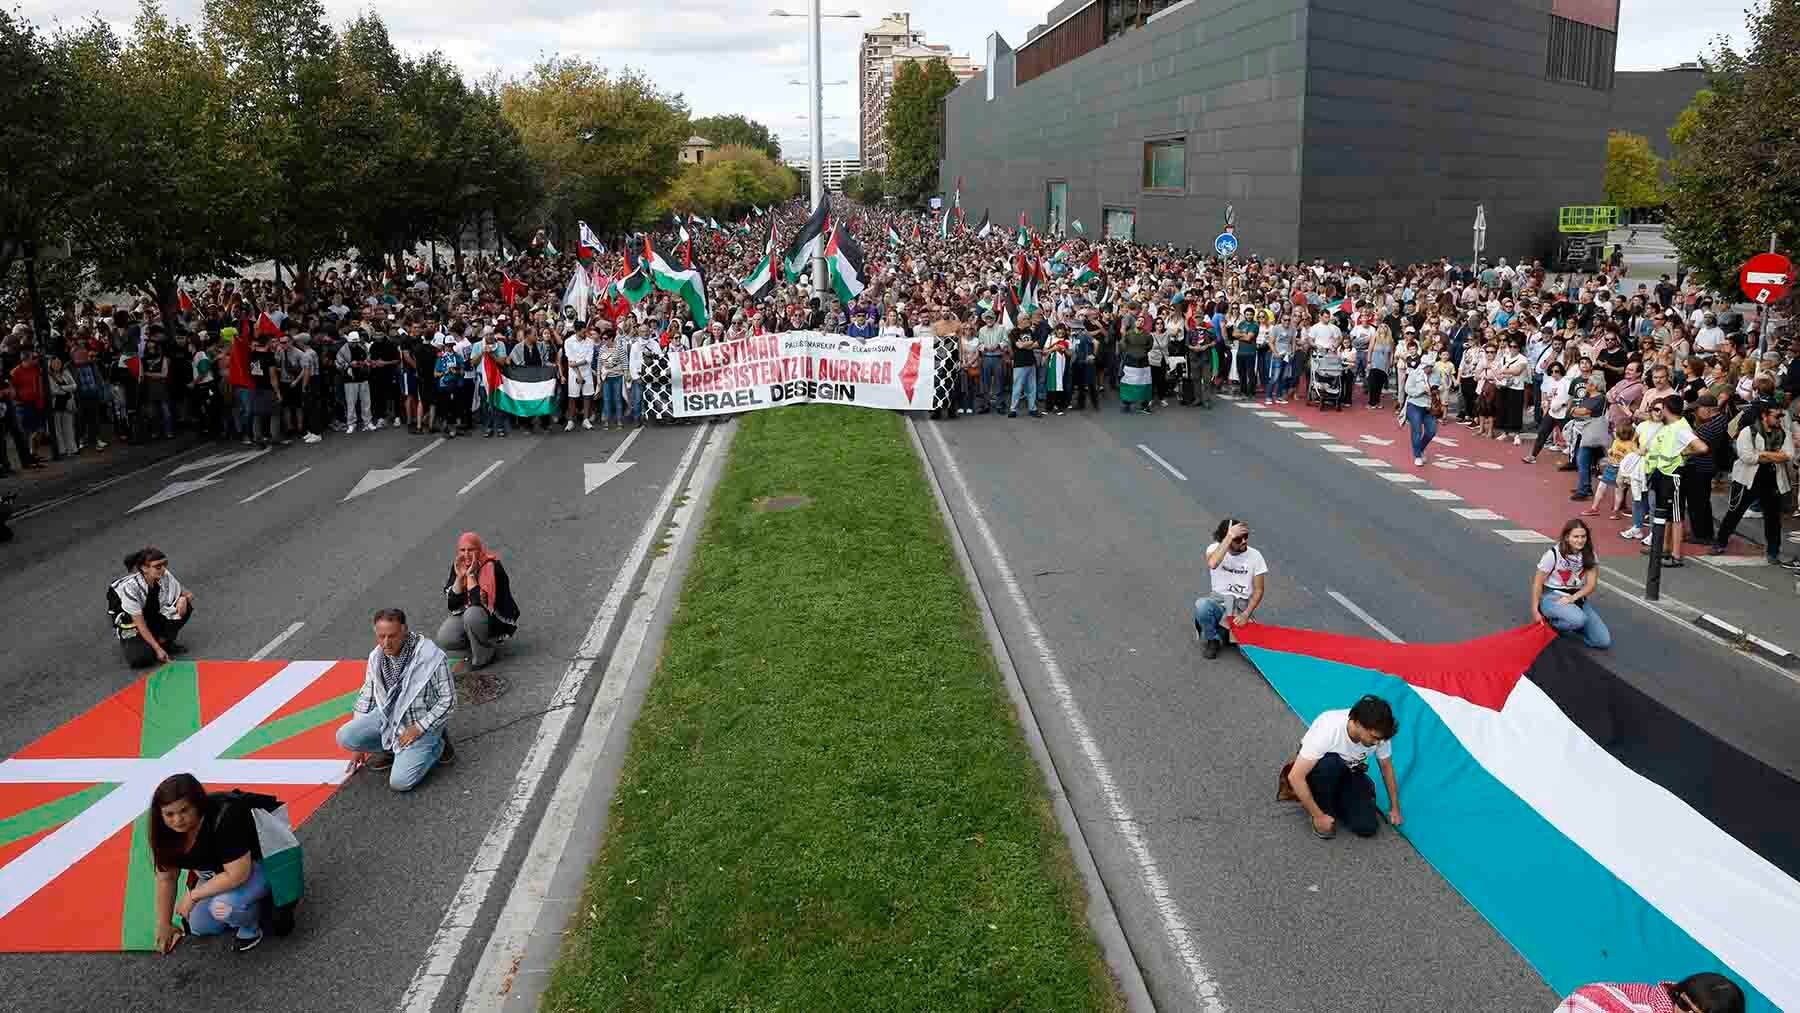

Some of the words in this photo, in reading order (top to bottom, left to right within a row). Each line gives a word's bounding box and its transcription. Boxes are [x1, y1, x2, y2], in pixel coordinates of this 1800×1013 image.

[680, 336, 779, 371] PALESTINAR
[683, 356, 813, 393] ERRESISTENTZIA
[818, 358, 892, 384] AURRERA
[684, 389, 763, 411] ISRAEL
[770, 380, 855, 402] DESEGIN
